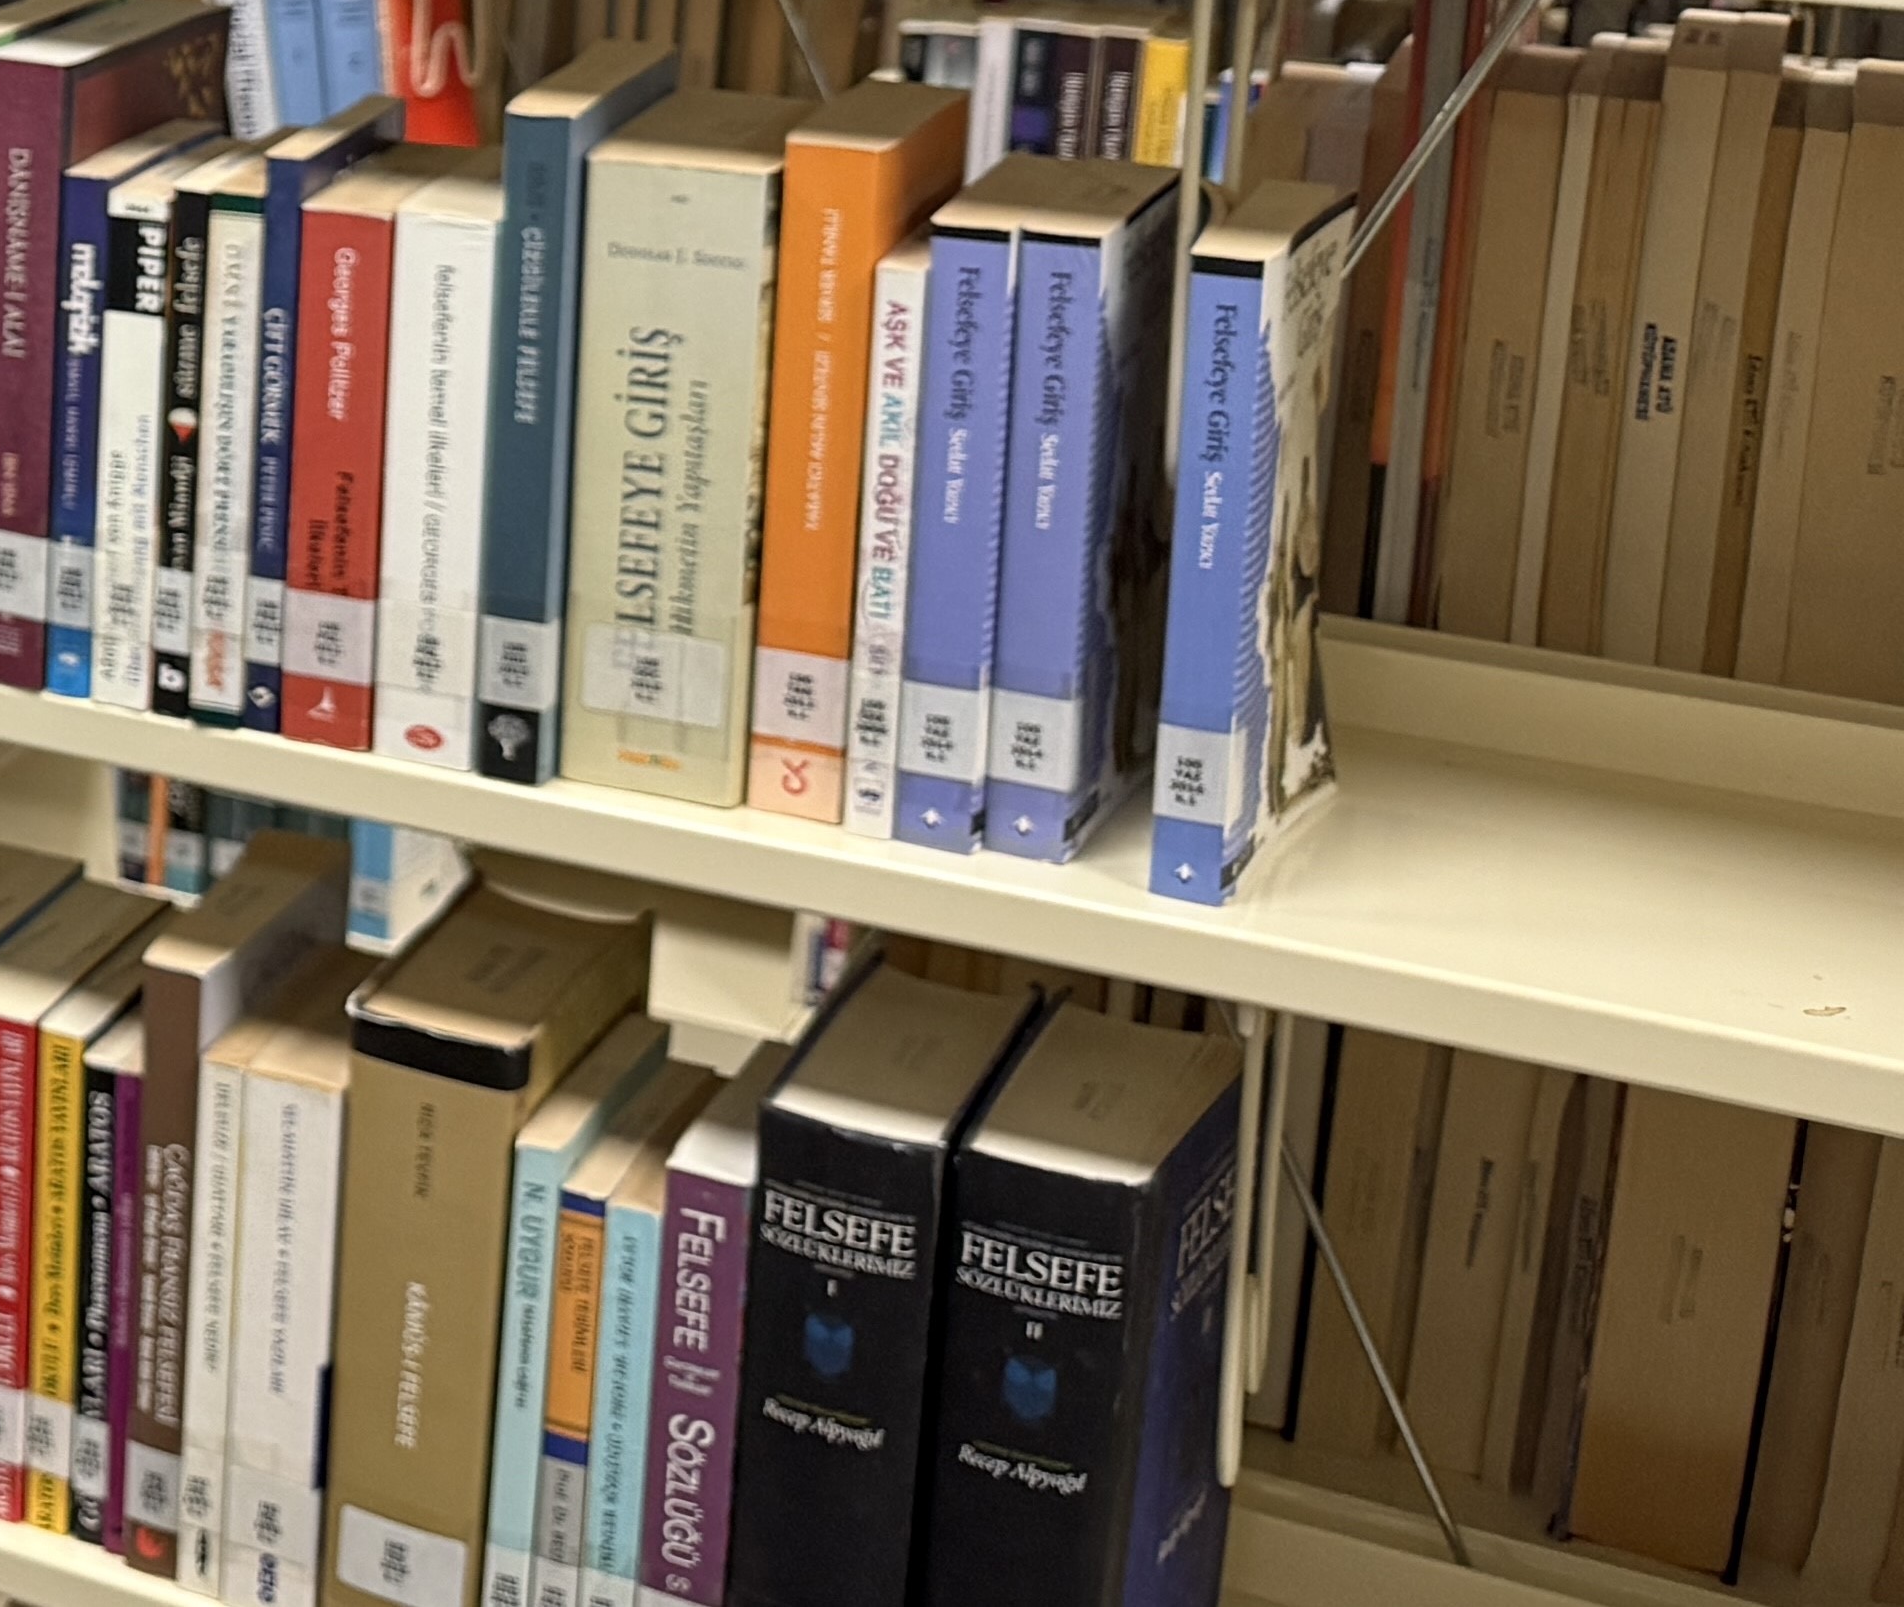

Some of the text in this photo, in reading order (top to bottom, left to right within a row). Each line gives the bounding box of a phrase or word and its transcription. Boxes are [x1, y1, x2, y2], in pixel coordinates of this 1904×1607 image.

[132, 225, 166, 312] PIPER
[326, 247, 359, 421] Georges Politzer
[951, 266, 983, 365] Felsefeye
[1041, 271, 1073, 369] Felsefeye
[1207, 303, 1239, 405] Felsefeye
[428, 368, 451, 427] temel
[613, 326, 682, 439] GİRİŞ
[945, 369, 978, 421] Giriş
[1034, 373, 1067, 427] Giriş
[867, 300, 908, 621] AŞK VE AKIL DOĞU VE BATI
[1201, 409, 1234, 462] Giriş
[1201, 470, 1224, 517] Sedat
[669, 523, 699, 636] Hikmetin
[83, 1091, 113, 1197] ARATOS
[518, 1180, 545, 1299] N. UYGUR
[762, 1190, 918, 1259] FELSEFE
[959, 1230, 1125, 1297] FELSEFE
[1025, 1322, 1044, 1340] II
[661, 1206, 726, 1569] FELSEFE SÖZLÜĞÜ
[762, 1396, 810, 1432] Recep
[958, 1443, 1012, 1476] Recep
